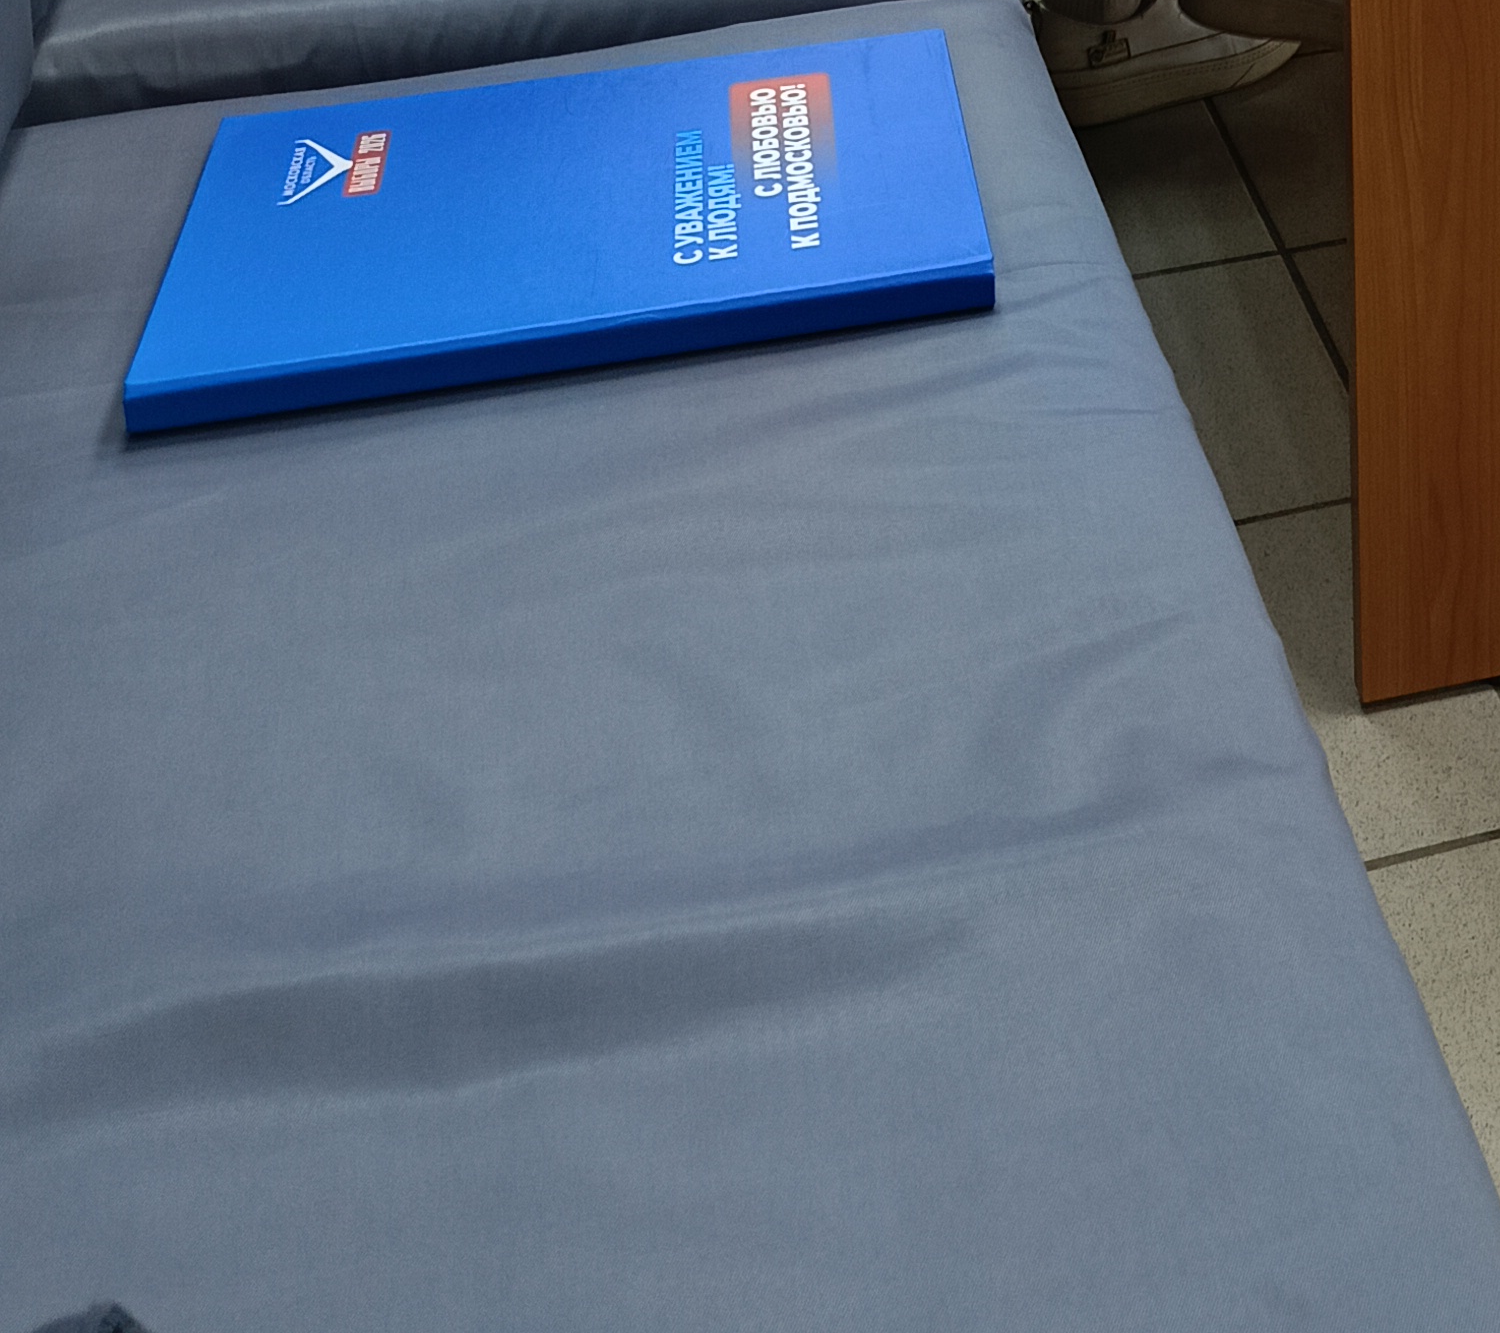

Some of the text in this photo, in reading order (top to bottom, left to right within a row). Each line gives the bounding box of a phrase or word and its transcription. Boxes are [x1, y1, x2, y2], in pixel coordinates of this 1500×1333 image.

[672, 130, 704, 265] С УВАЖЕНИЕМ
[749, 87, 783, 198] С ЛЮБОВЬЮ
[779, 83, 821, 250] К ПОДМОСКОВЬЮ!
[706, 163, 742, 261] К ЛЮДЯМ!
